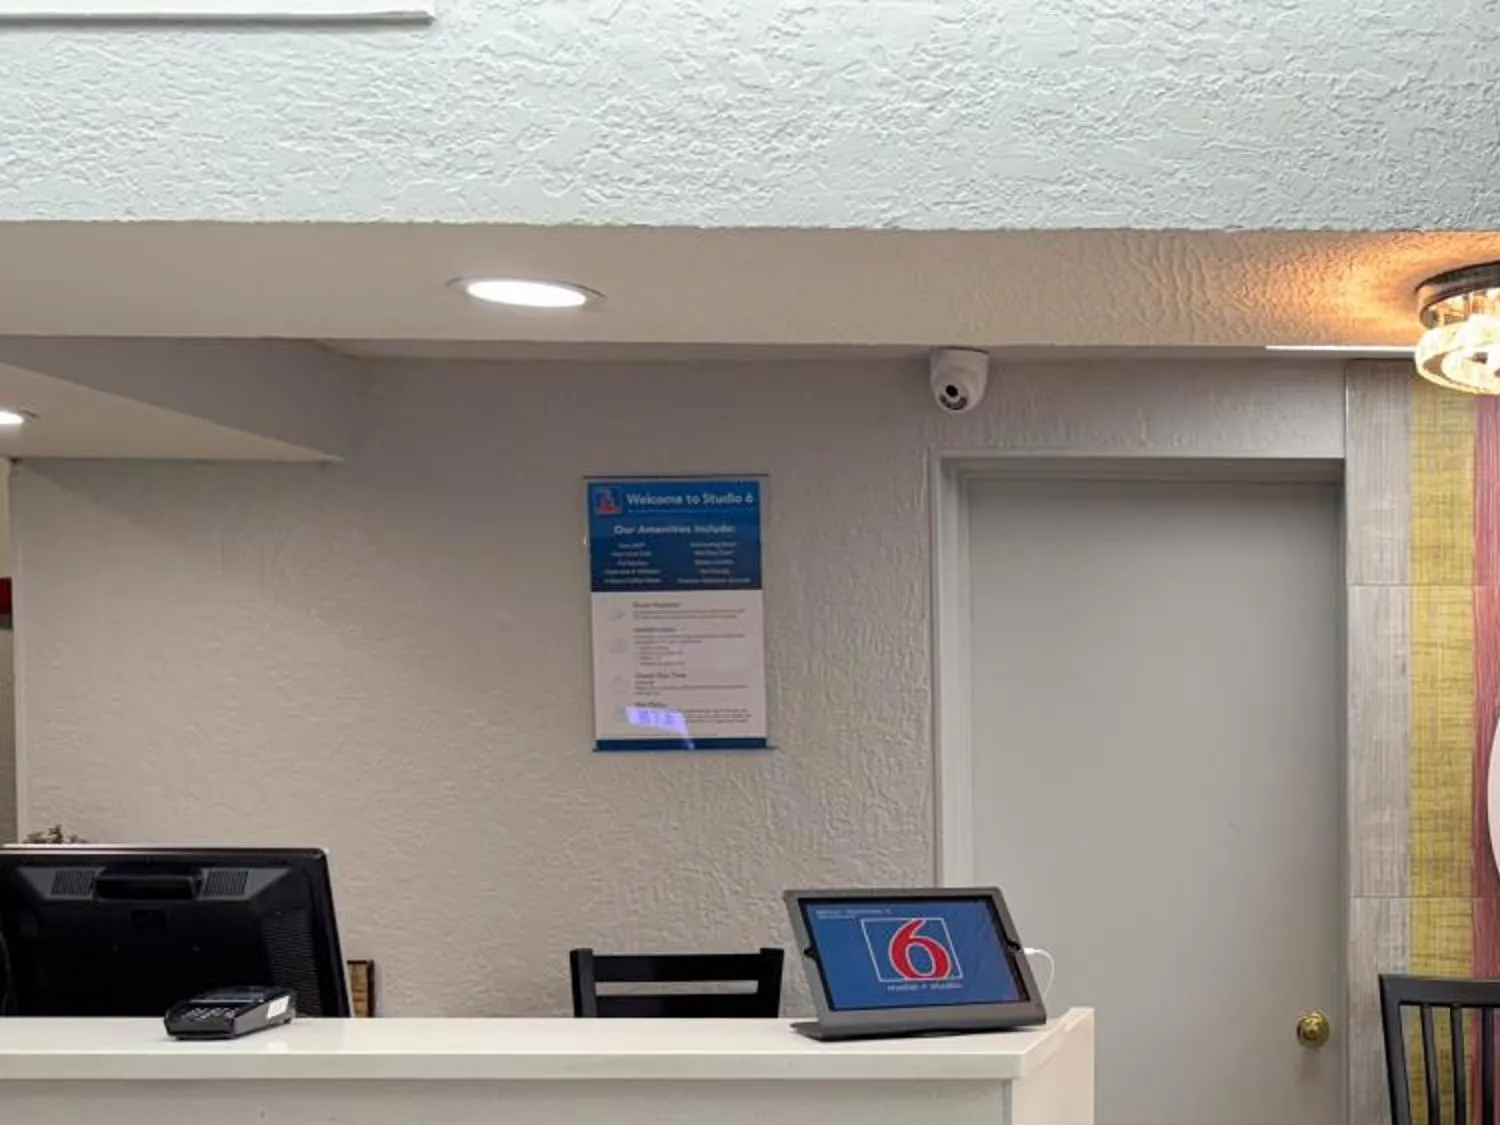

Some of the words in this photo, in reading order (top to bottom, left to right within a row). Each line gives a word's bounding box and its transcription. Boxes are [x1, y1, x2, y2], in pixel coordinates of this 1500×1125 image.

[626, 493, 685, 505] Welcome
[686, 493, 700, 505] to
[702, 492, 743, 506] Studio
[613, 525, 635, 535] Our
[887, 917, 952, 981] 6
